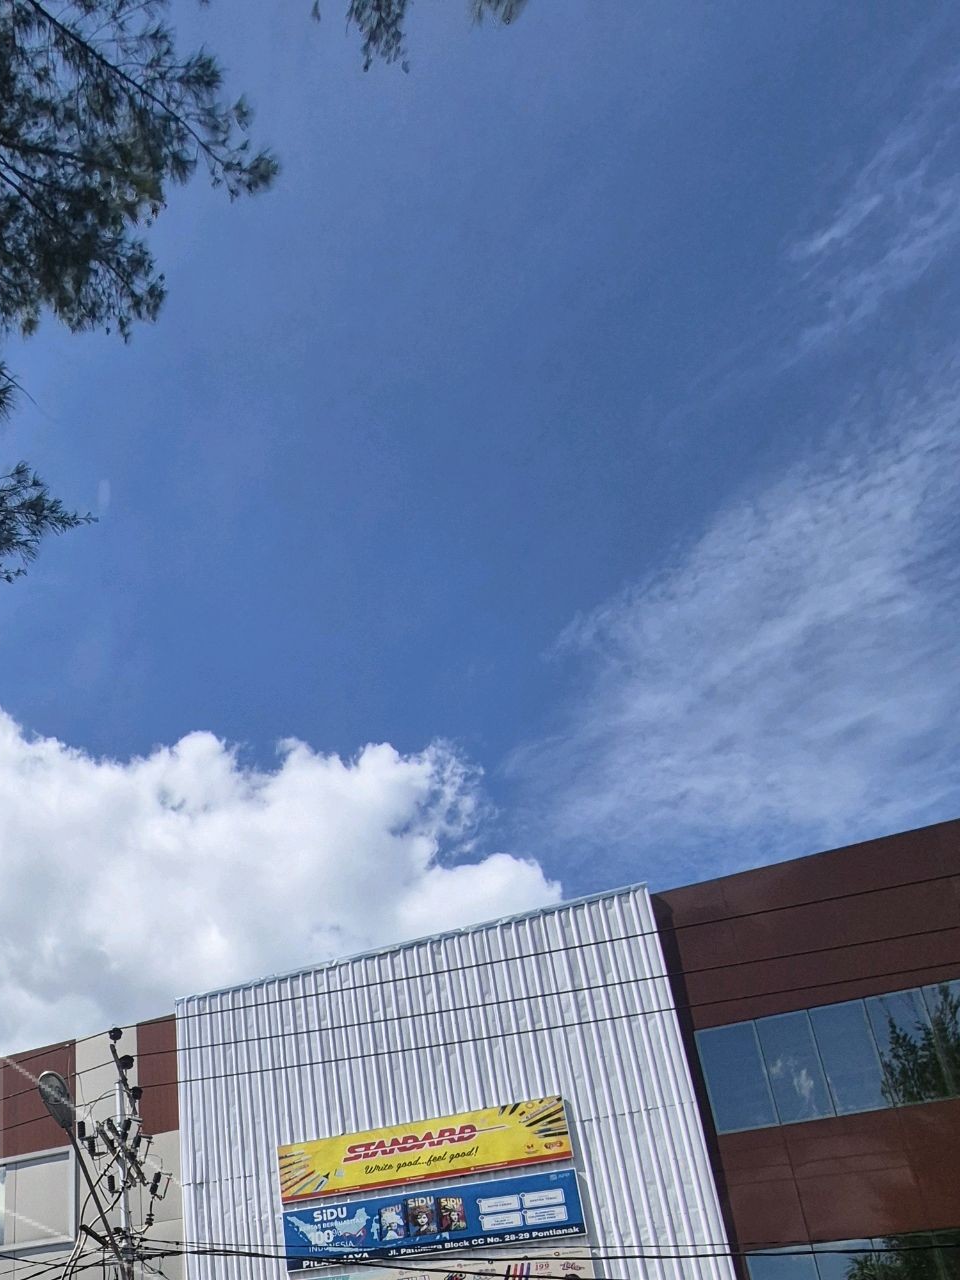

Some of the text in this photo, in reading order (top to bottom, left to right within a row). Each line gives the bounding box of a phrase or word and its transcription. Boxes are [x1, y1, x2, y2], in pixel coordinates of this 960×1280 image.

[343, 1124, 478, 1162] STANDARD
[365, 1163, 394, 1174] Write
[449, 1146, 479, 1163] good!
[313, 1206, 347, 1222] SiDU
[444, 1241, 470, 1249] Block
[471, 1238, 485, 1246] CC
[487, 1236, 502, 1244] No.
[532, 1226, 580, 1238] Pontianak
